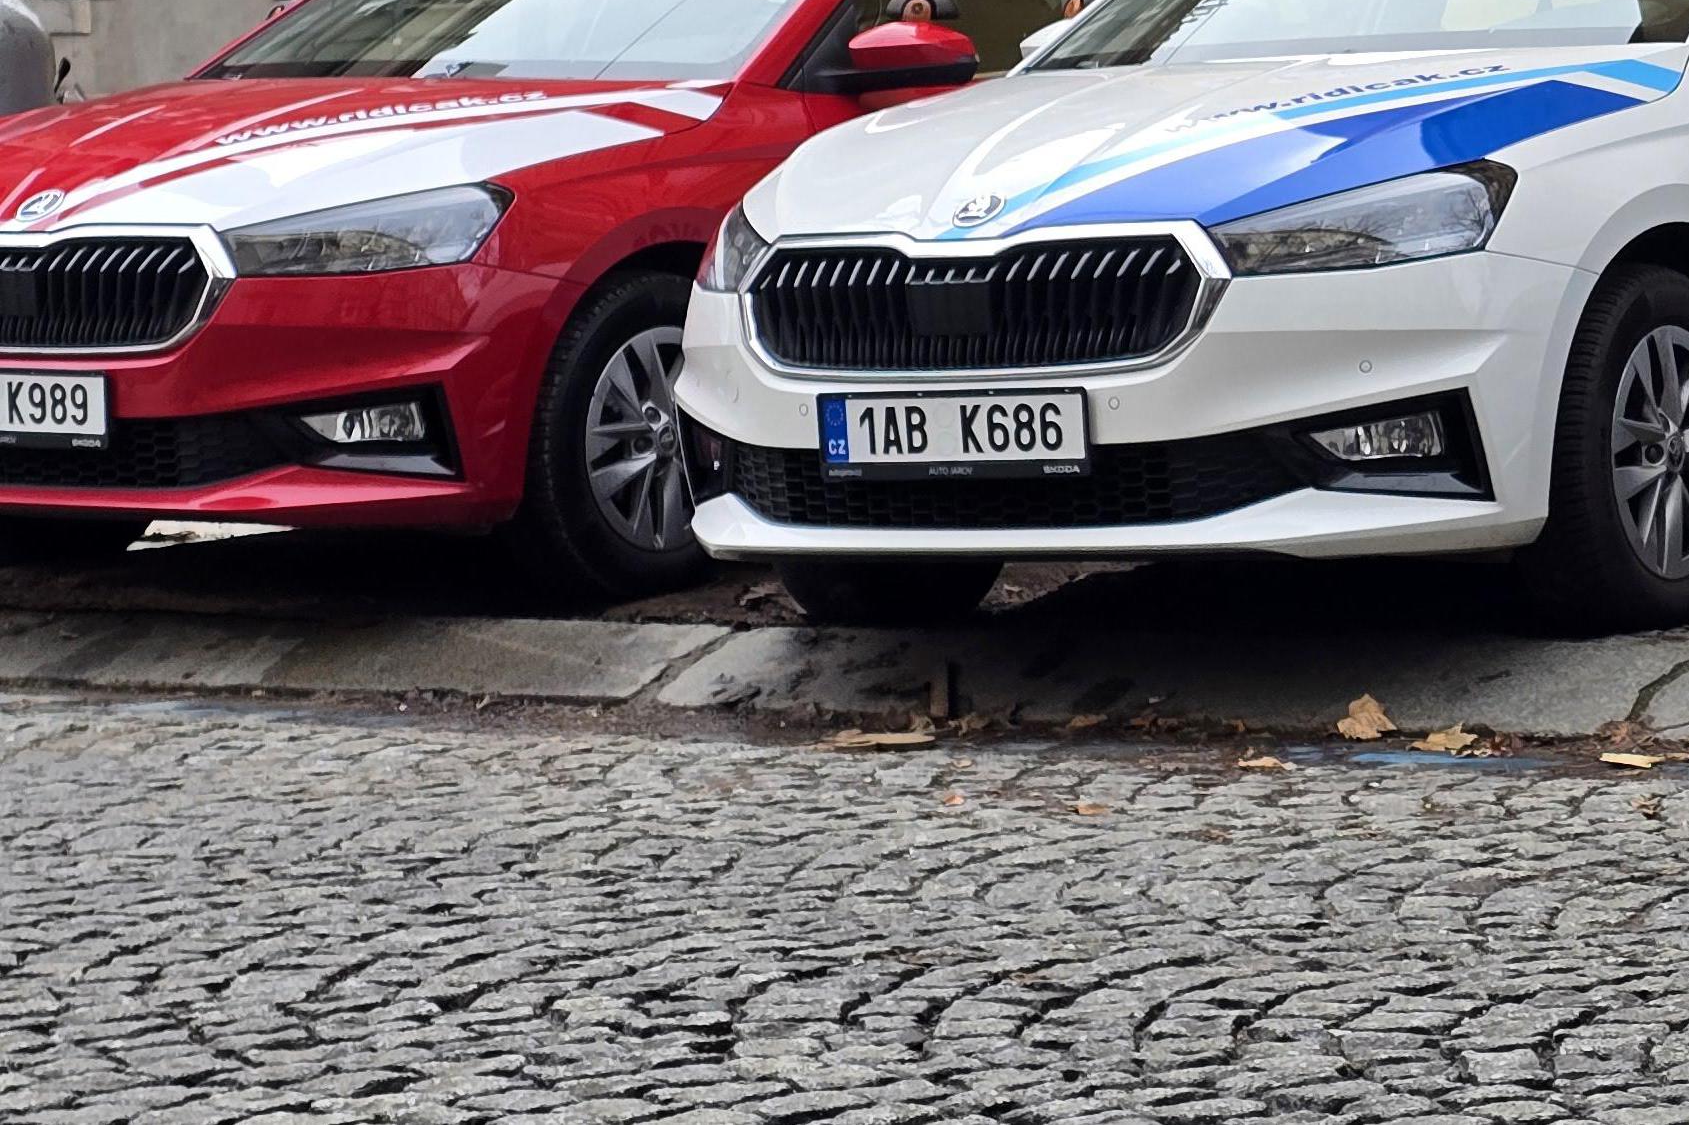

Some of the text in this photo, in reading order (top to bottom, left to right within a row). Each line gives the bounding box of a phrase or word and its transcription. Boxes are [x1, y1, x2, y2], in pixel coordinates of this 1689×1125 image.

[215, 90, 548, 146] www.ridicak.cz
[1164, 63, 1511, 133] w.ridicak.cz
[7, 380, 89, 427] K989
[828, 401, 1064, 456] CZ 1AB K686
